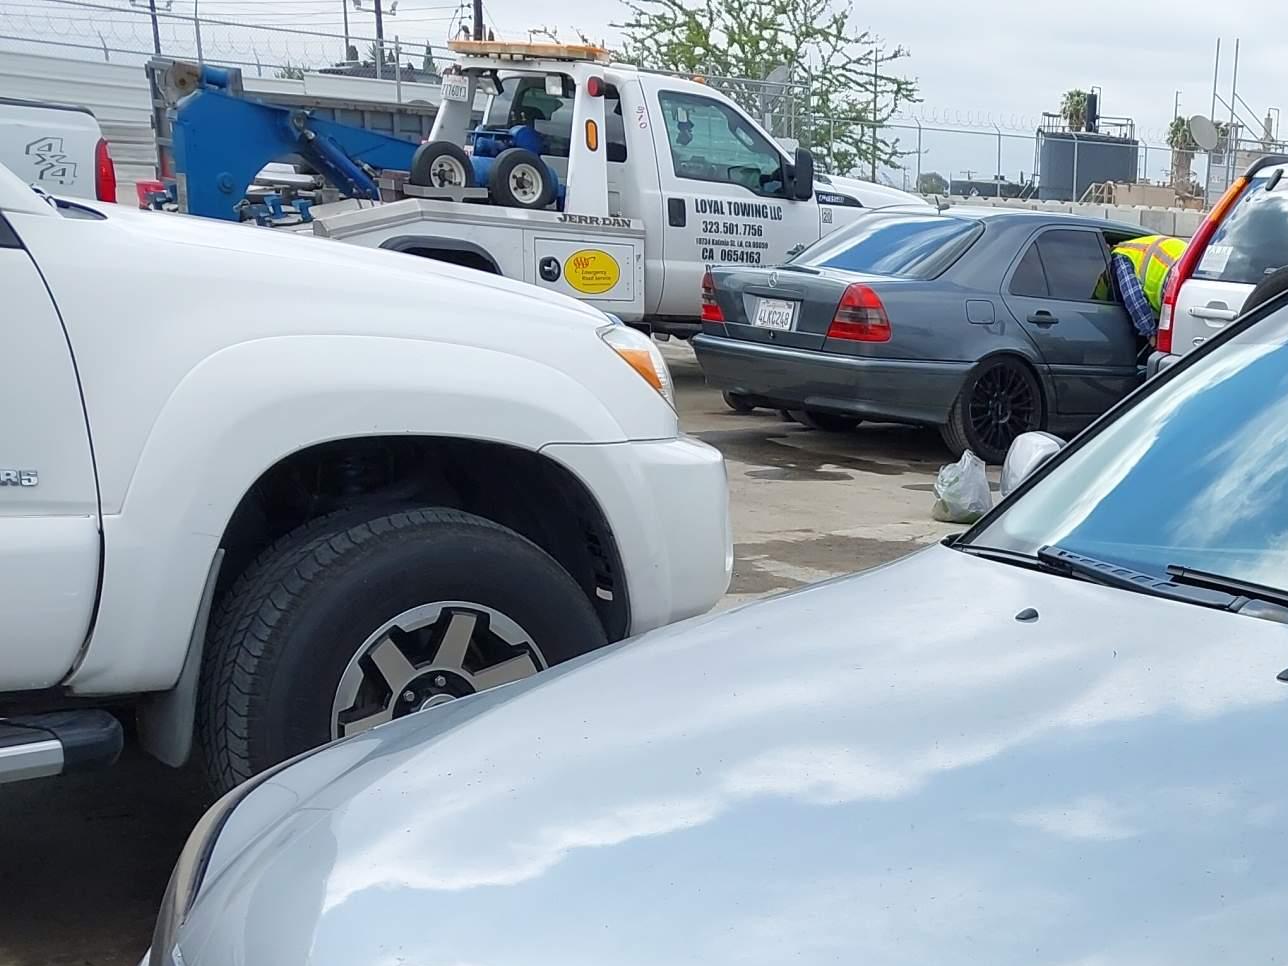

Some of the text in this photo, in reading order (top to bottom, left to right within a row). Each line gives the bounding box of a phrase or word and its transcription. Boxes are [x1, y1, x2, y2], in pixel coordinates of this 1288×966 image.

[694, 198, 783, 221] LOYAL TOWING LLC
[702, 220, 763, 237] 323.501.7756
[701, 247, 761, 264] CA 0654163
